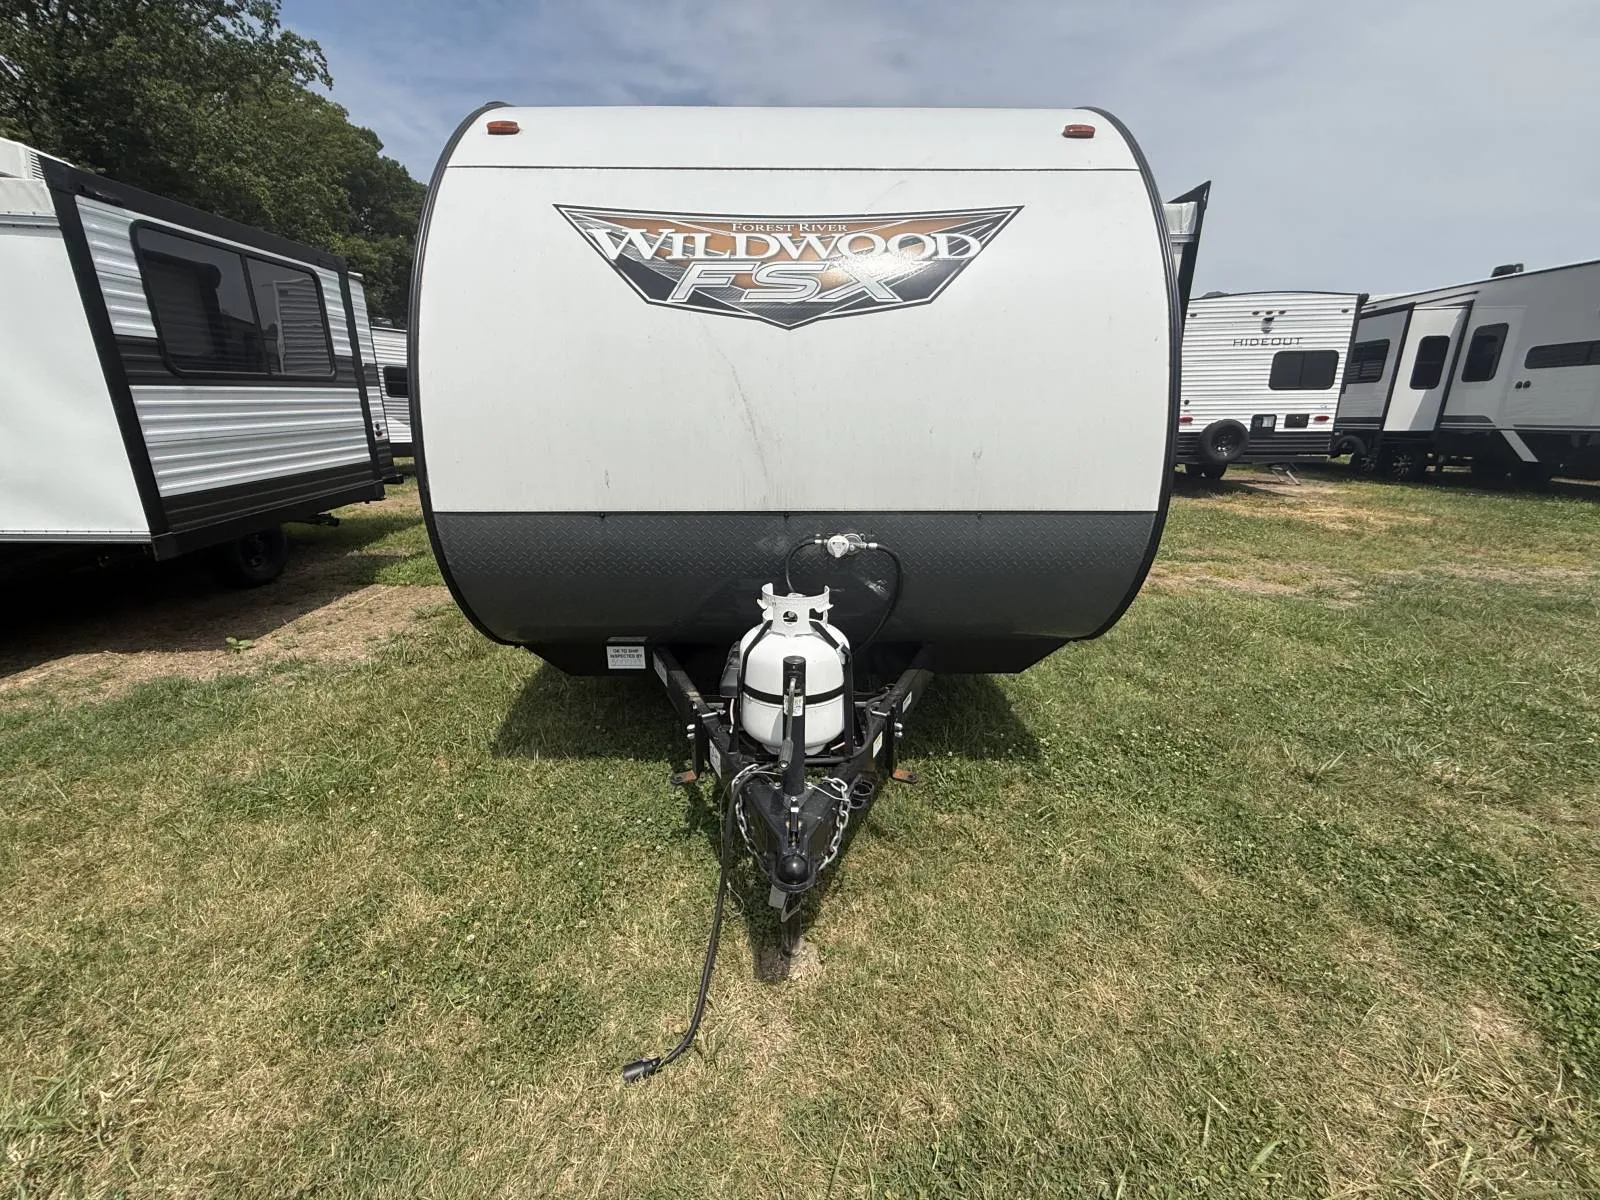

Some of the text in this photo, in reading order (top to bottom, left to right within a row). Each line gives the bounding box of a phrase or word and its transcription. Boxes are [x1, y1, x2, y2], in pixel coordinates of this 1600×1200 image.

[731, 222, 848, 232] FOREST RIVER
[587, 228, 982, 262] WILDWOOD
[668, 261, 903, 303] FSX
[1233, 337, 1303, 347] HIDEOUT
